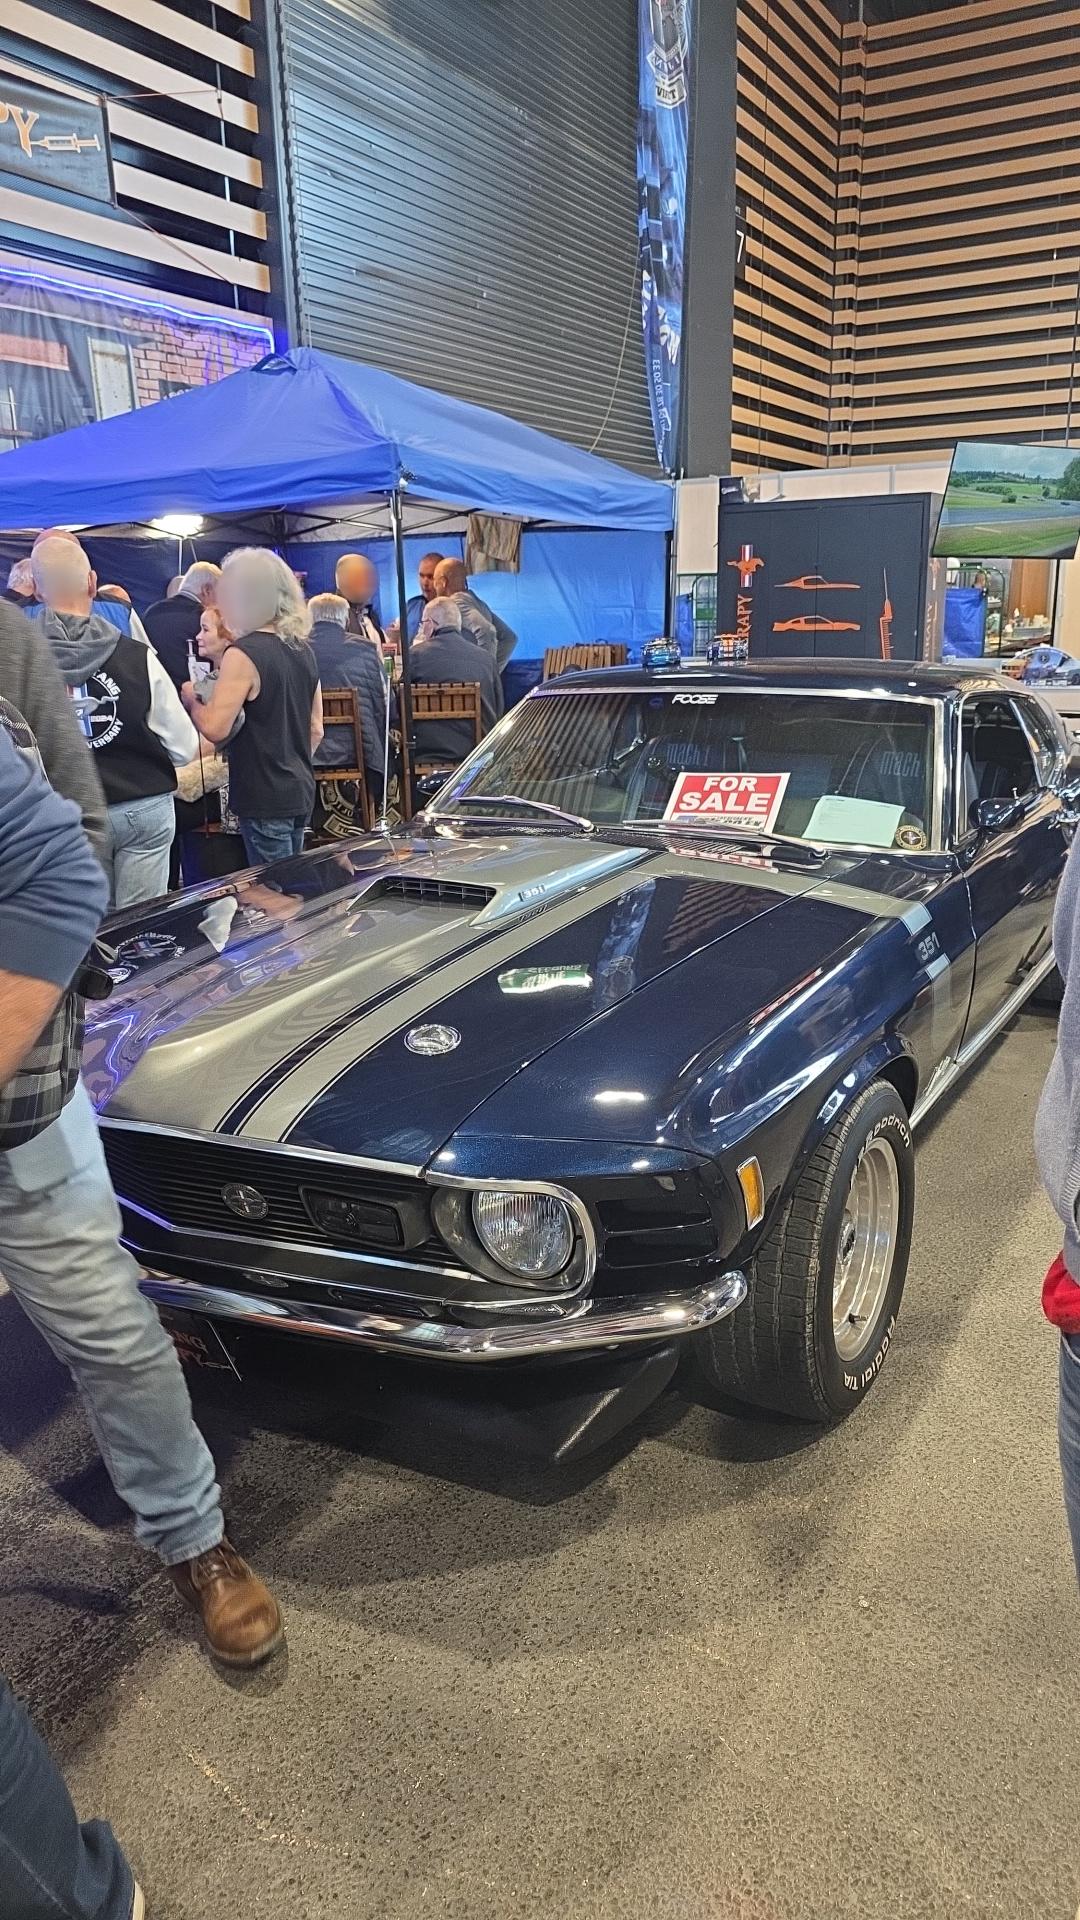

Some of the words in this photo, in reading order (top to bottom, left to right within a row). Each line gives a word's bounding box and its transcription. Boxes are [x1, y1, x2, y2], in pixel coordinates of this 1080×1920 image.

[93, 669, 121, 696] ANG
[671, 694, 719, 704] FOOSE
[703, 776, 758, 792] FOR
[679, 791, 771, 812] SALE
[918, 931, 940, 960] 351
